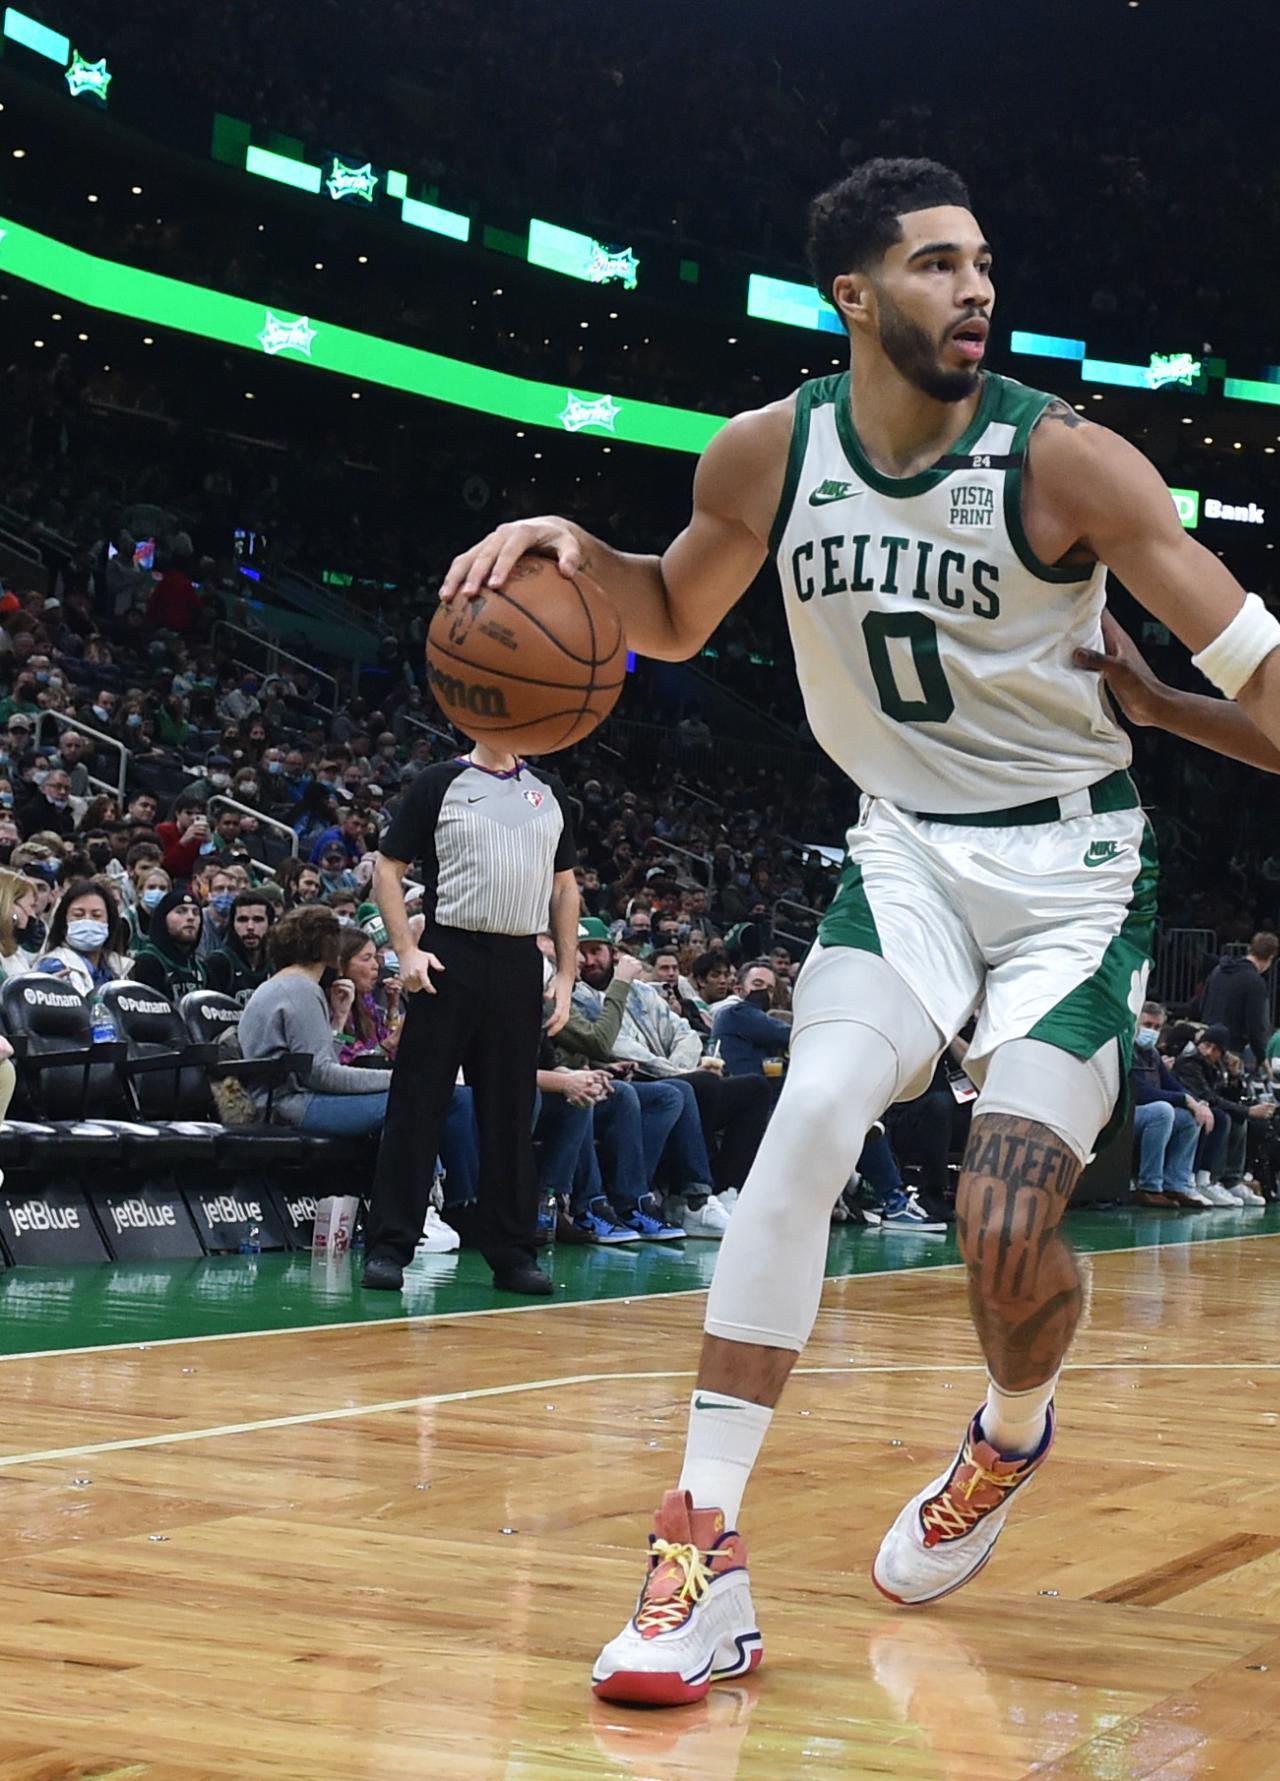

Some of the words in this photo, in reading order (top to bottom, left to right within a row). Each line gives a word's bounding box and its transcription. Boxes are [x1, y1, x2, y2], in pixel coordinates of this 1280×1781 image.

[972, 455, 991, 468] 24
[817, 478, 852, 497] NIKE
[950, 486, 994, 508] VISTA
[950, 508, 994, 526] PRINT
[1204, 498, 1265, 524] Bank
[792, 534, 1000, 620] CELTICS
[861, 610, 955, 724] 0
[1090, 840, 1118, 856] NIKE
[37, 990, 83, 1009] Putnam
[128, 998, 172, 1015] Putnam
[6, 1200, 81, 1237] jetBlue
[107, 1199, 177, 1235] jetBlue
[200, 1195, 264, 1229] jetBlue
